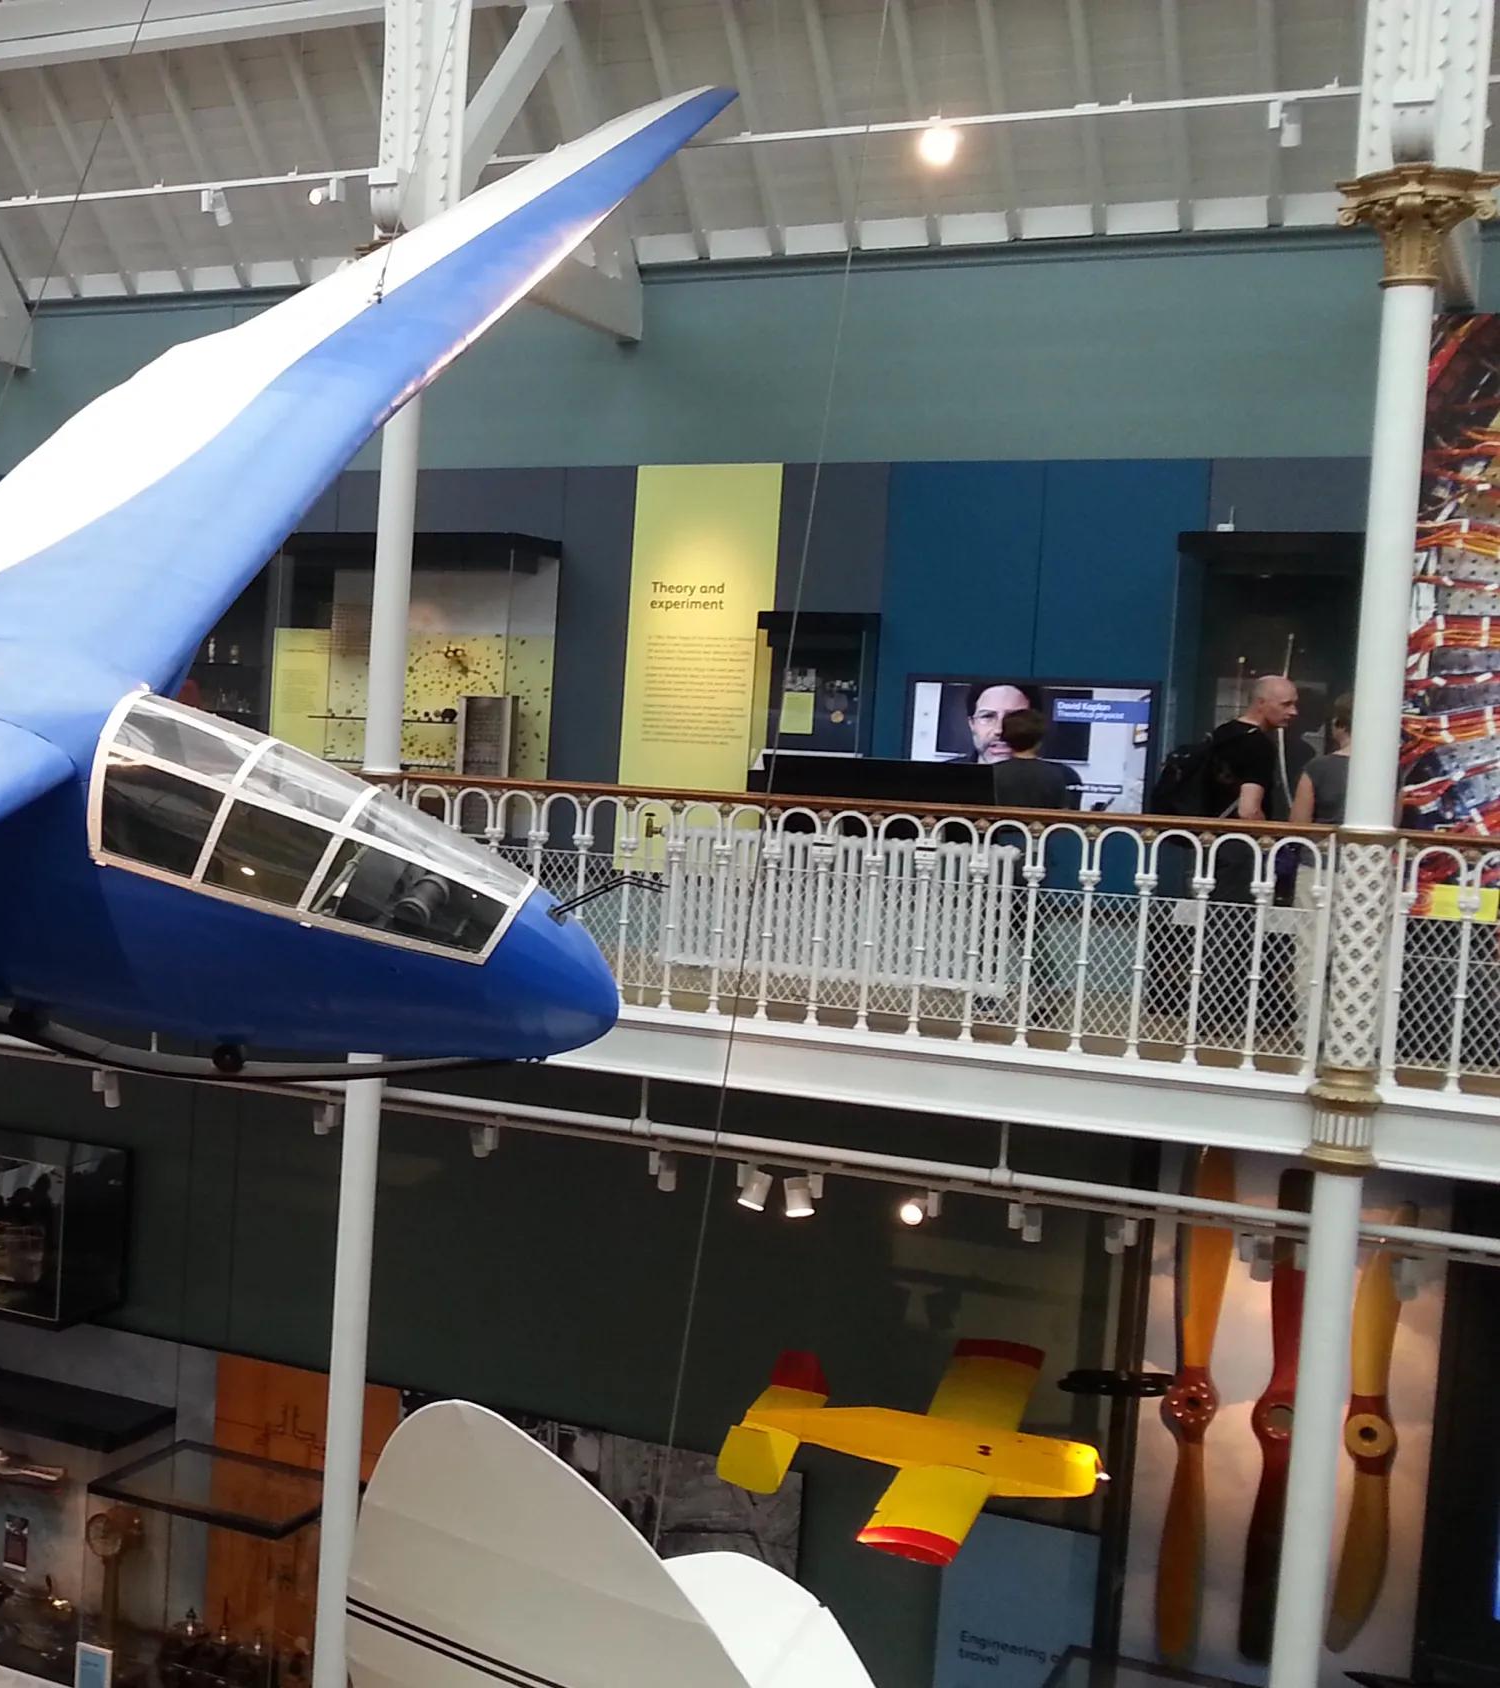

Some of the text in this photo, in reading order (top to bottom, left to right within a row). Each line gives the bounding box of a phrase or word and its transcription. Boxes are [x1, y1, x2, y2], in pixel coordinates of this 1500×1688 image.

[651, 581, 725, 597] Theory and
[649, 597, 725, 612] experiment
[1056, 701, 1112, 713] David Kaplan
[1056, 710, 1125, 721] Theoretical physicist
[959, 1629, 1046, 1665] Engineering
[958, 1648, 999, 1666] travel
